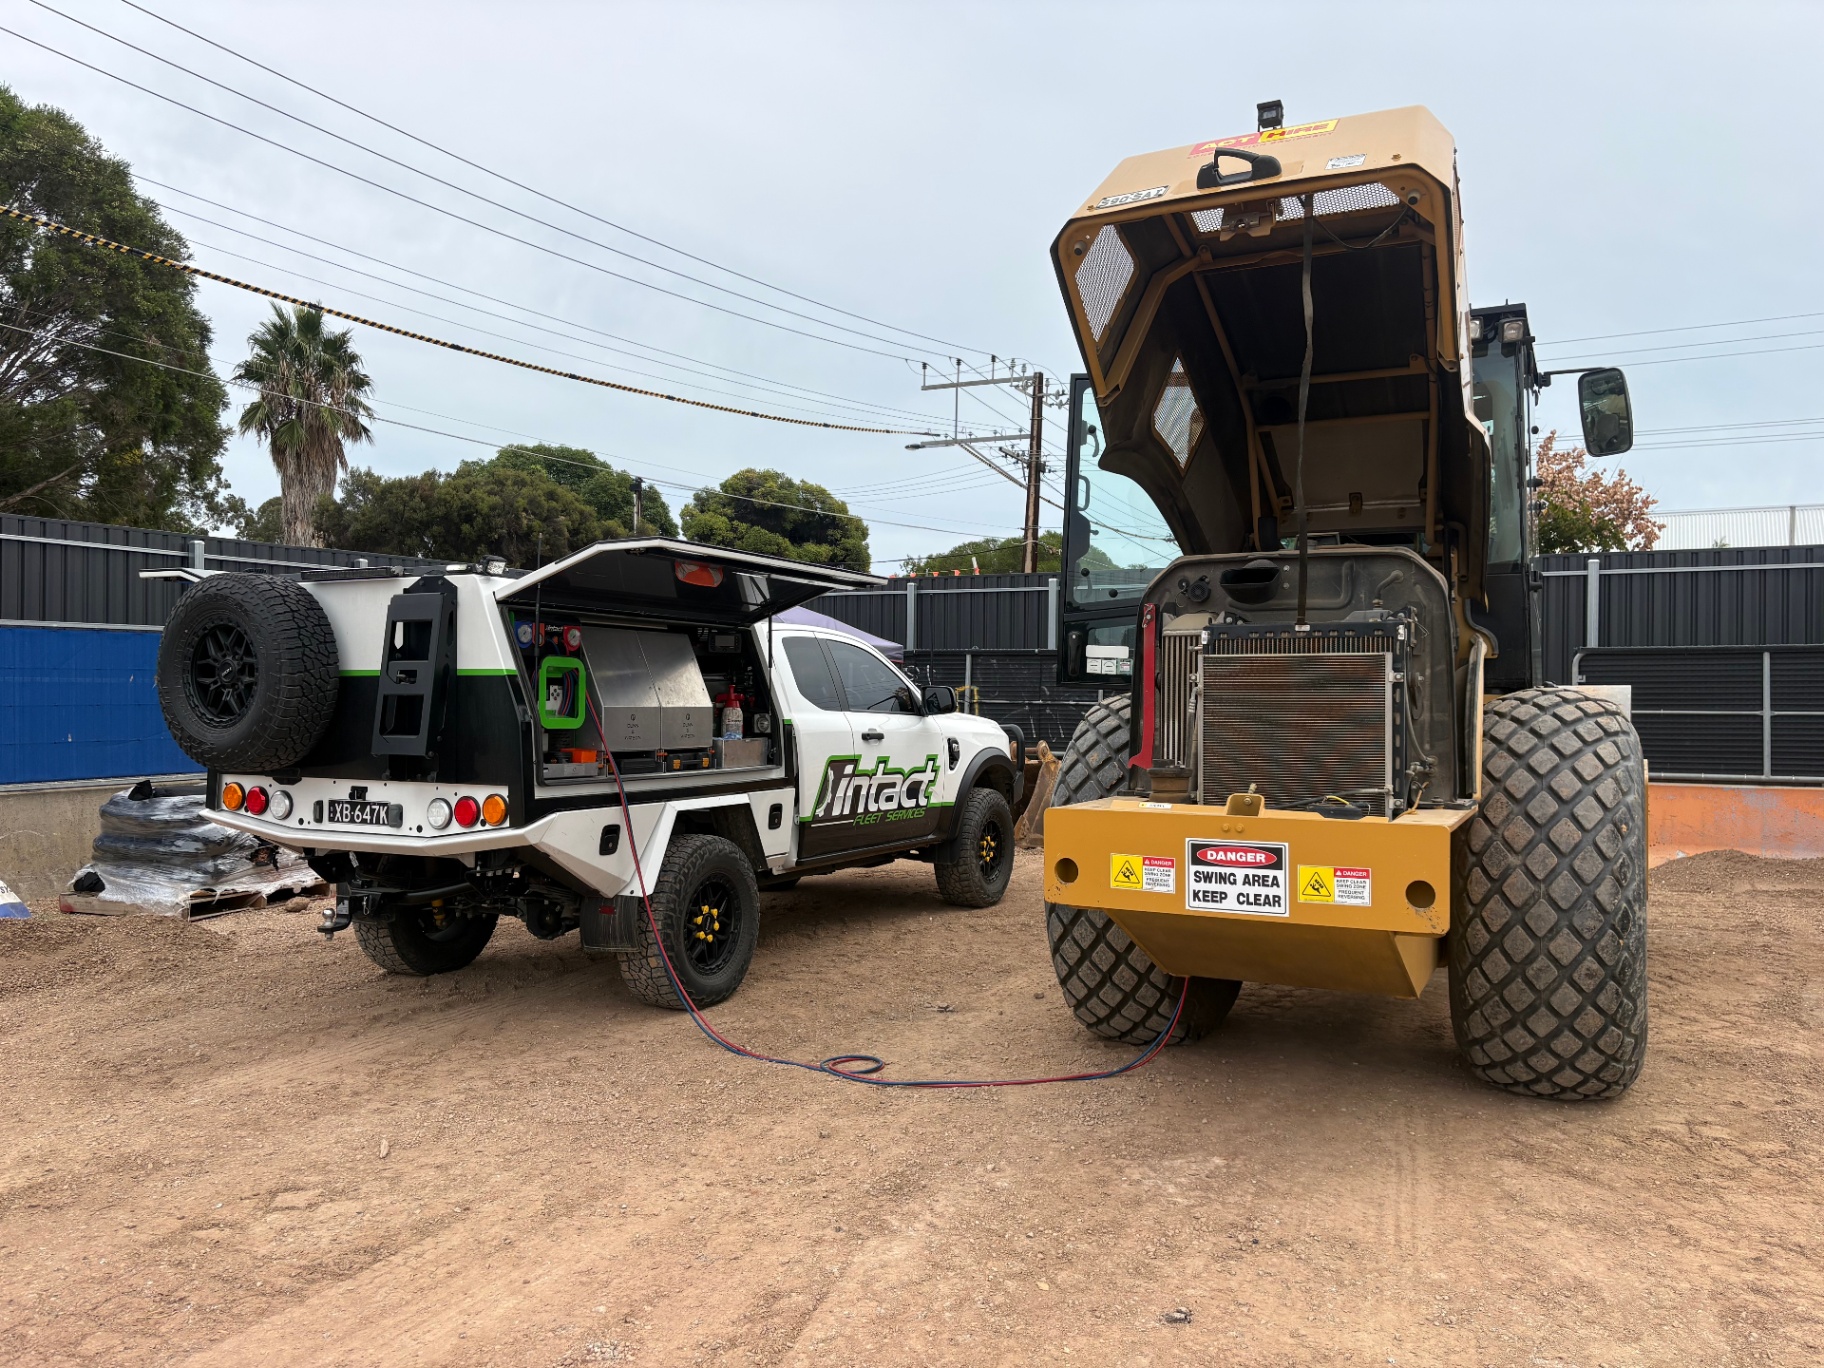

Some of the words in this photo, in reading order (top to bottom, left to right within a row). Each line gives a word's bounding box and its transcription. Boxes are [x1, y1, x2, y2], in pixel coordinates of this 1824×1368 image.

[1200, 136, 1255, 150] ACT
[1266, 122, 1329, 139] HIRE
[853, 812, 883, 826] FLEET
[886, 807, 926, 822] SERVICES
[1207, 850, 1266, 863] DANGER
[1194, 870, 1237, 886] SWING
[1242, 874, 1280, 888] AREA
[1192, 889, 1228, 904] KEEP
[1236, 892, 1282, 908] CLEAR
